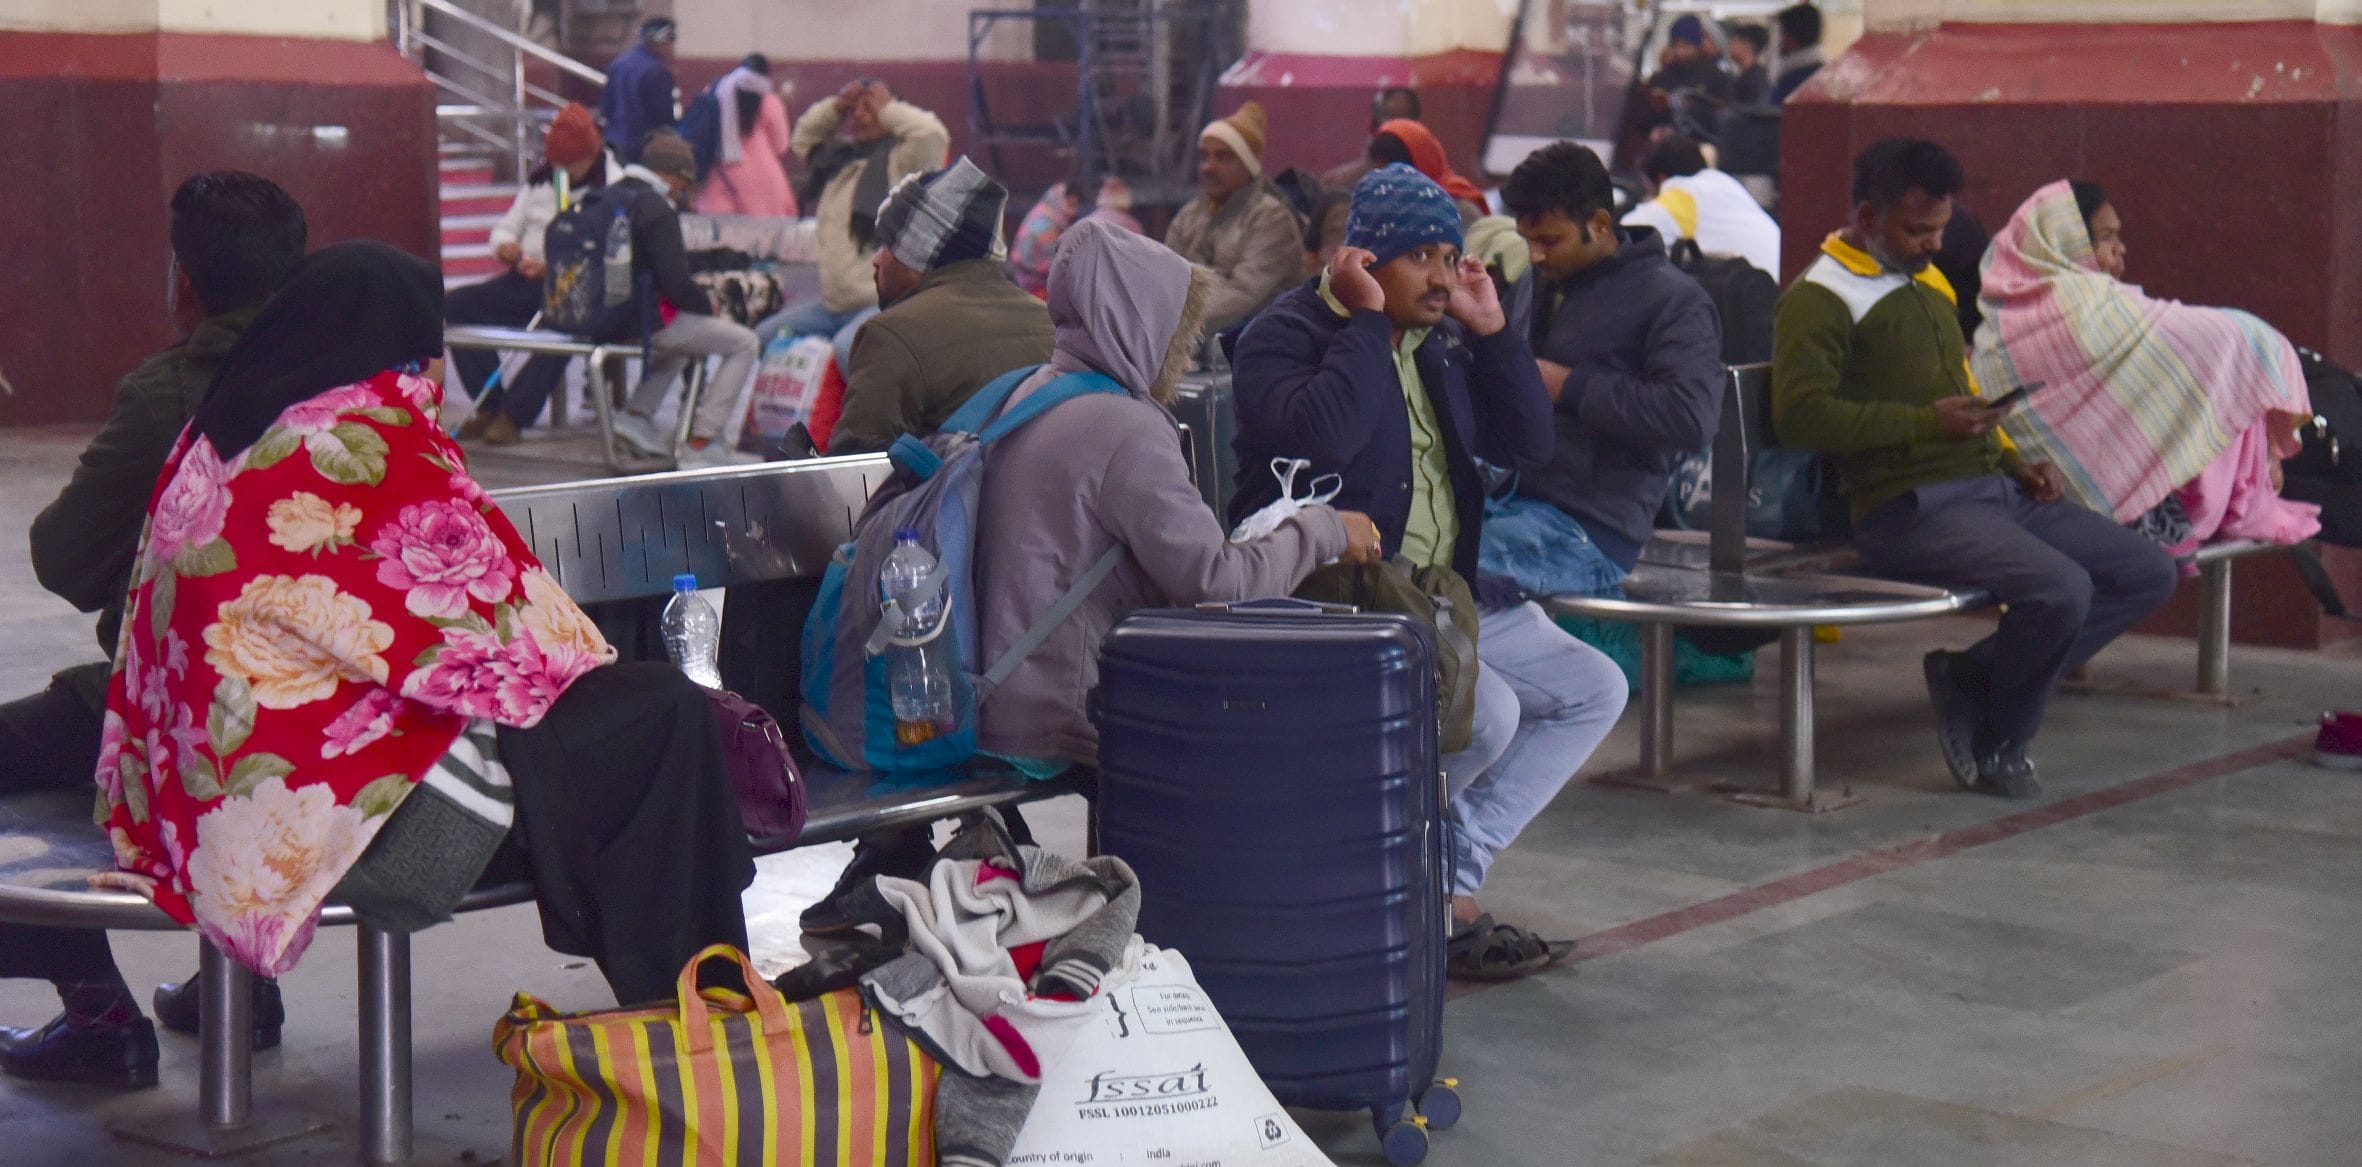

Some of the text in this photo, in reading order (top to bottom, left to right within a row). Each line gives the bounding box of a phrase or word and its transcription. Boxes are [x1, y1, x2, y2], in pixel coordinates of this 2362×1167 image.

[1087, 1062, 1211, 1103] fssai
[1079, 1096, 1218, 1120] FSSL 10012051000222
[1049, 1151, 1060, 1162] of
[1063, 1151, 1094, 1163] origin
